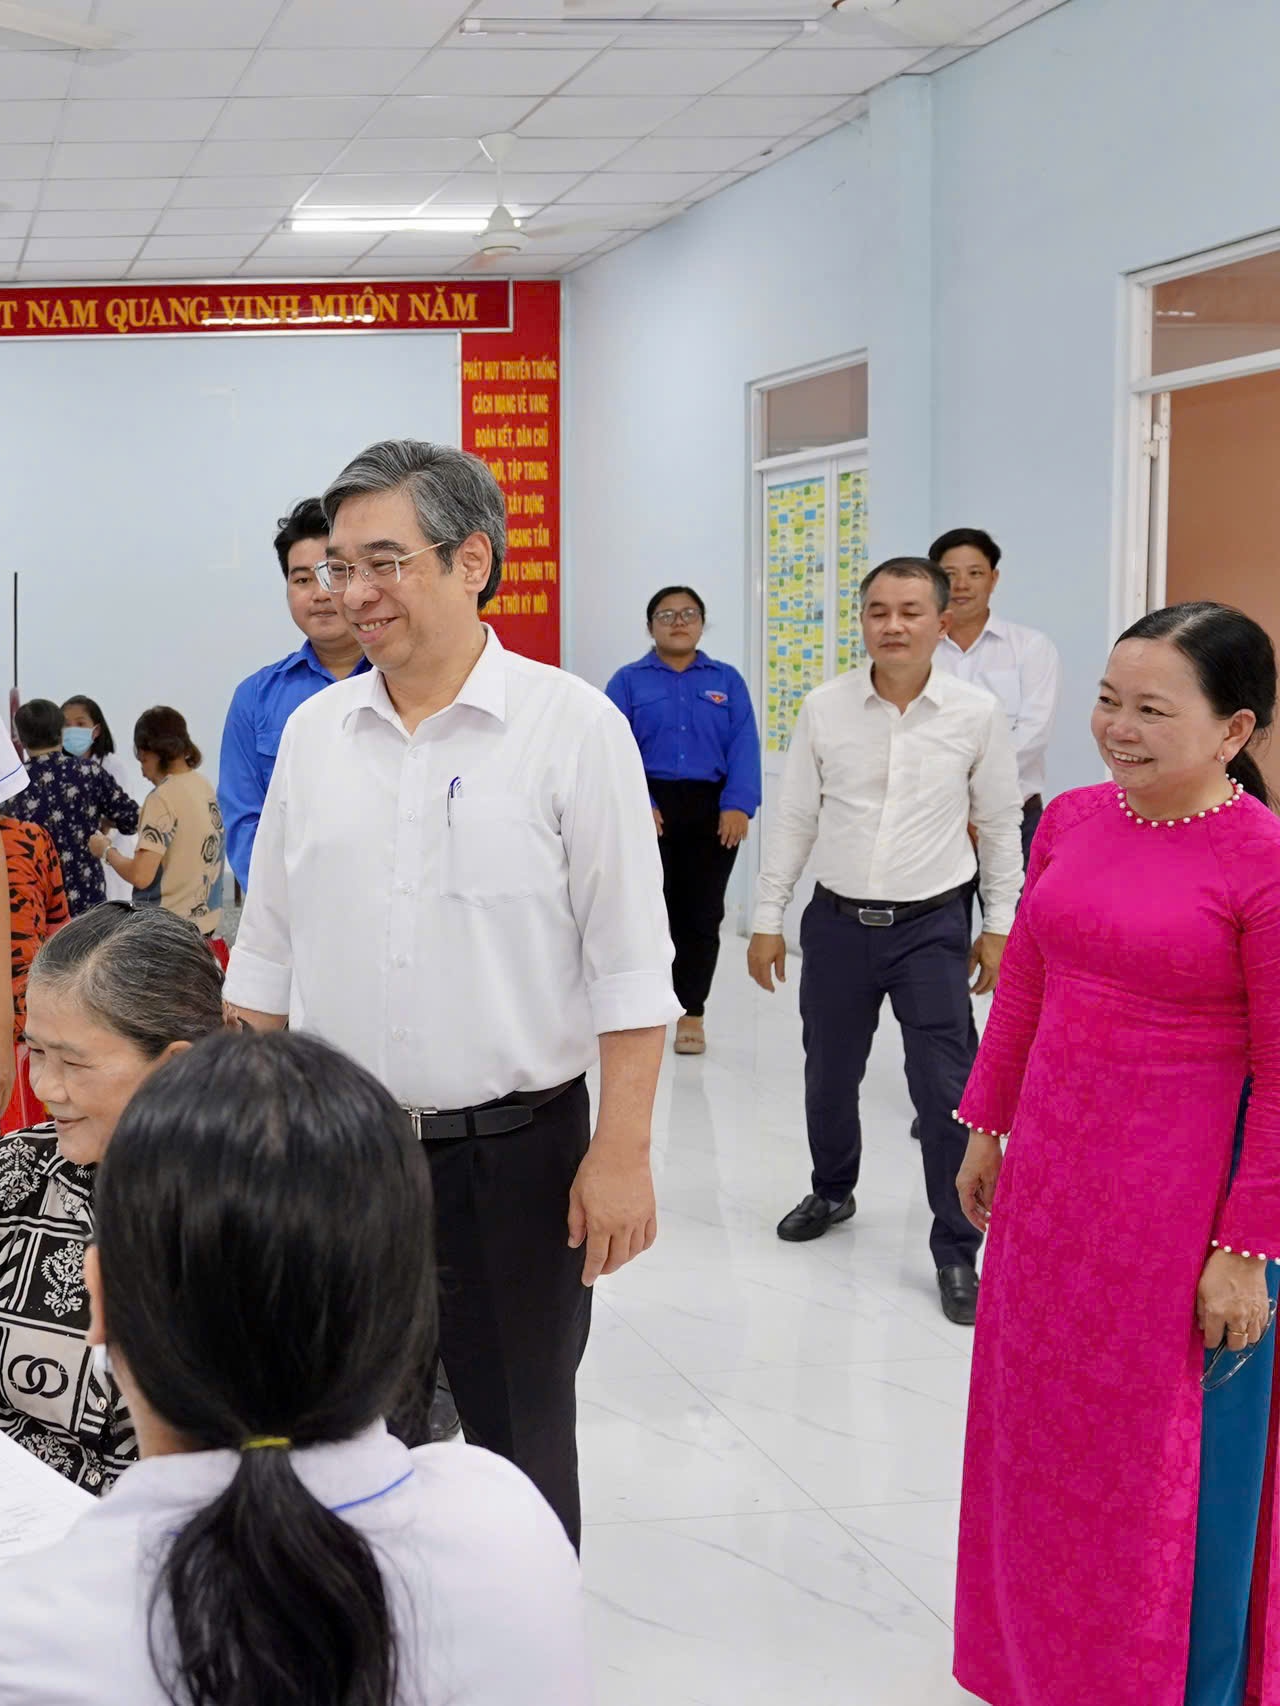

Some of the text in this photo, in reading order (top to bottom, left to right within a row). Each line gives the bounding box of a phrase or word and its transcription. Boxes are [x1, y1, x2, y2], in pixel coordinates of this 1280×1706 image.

[26, 298, 99, 328] NAM
[105, 296, 210, 334] QUANG
[220, 295, 301, 323] VINH
[310, 285, 400, 322] MUÔN
[408, 285, 479, 322] NĂM
